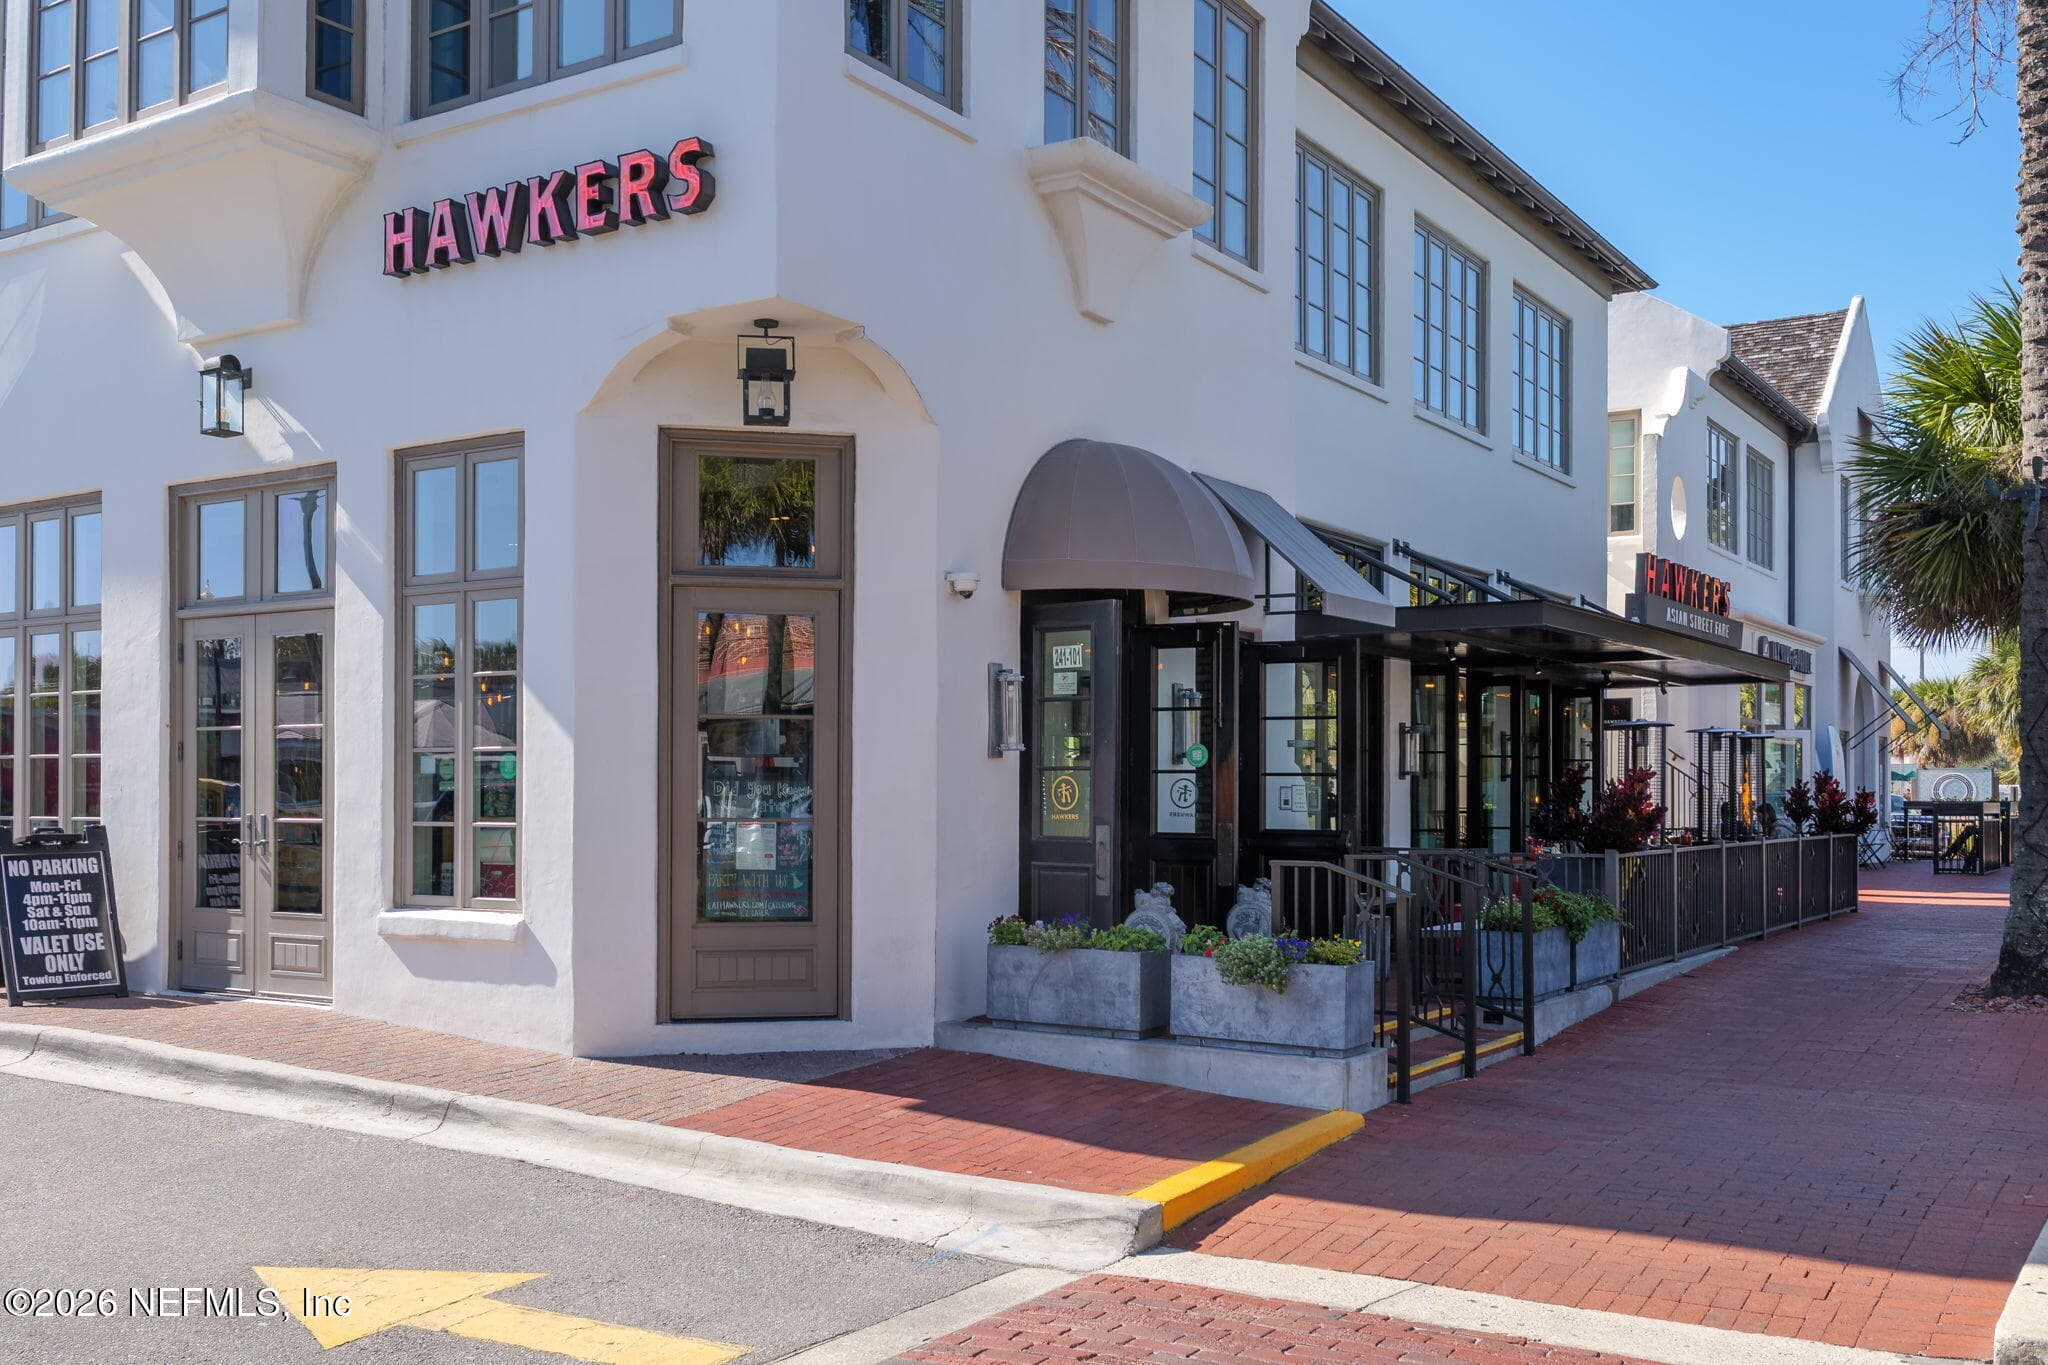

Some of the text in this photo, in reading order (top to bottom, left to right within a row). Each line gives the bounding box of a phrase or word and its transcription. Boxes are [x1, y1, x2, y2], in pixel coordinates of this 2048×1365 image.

[383, 136, 716, 278] HAWKERS
[1637, 552, 1731, 618] HAWKERS
[1666, 606, 1730, 638] ASIAN STREET FARE
[713, 781, 739, 797] Did
[7, 857, 100, 877] NO PARKING
[30, 879, 82, 893] Mon-Fri
[742, 872, 769, 888] WITH
[23, 892, 92, 906] 4pm-11pm
[26, 904, 91, 918] Sat & Sun
[22, 917, 98, 931] 10am-11pm
[20, 933, 105, 955] VALET USE
[45, 953, 85, 973] ONLY
[22, 970, 112, 985] Towing Enforced
